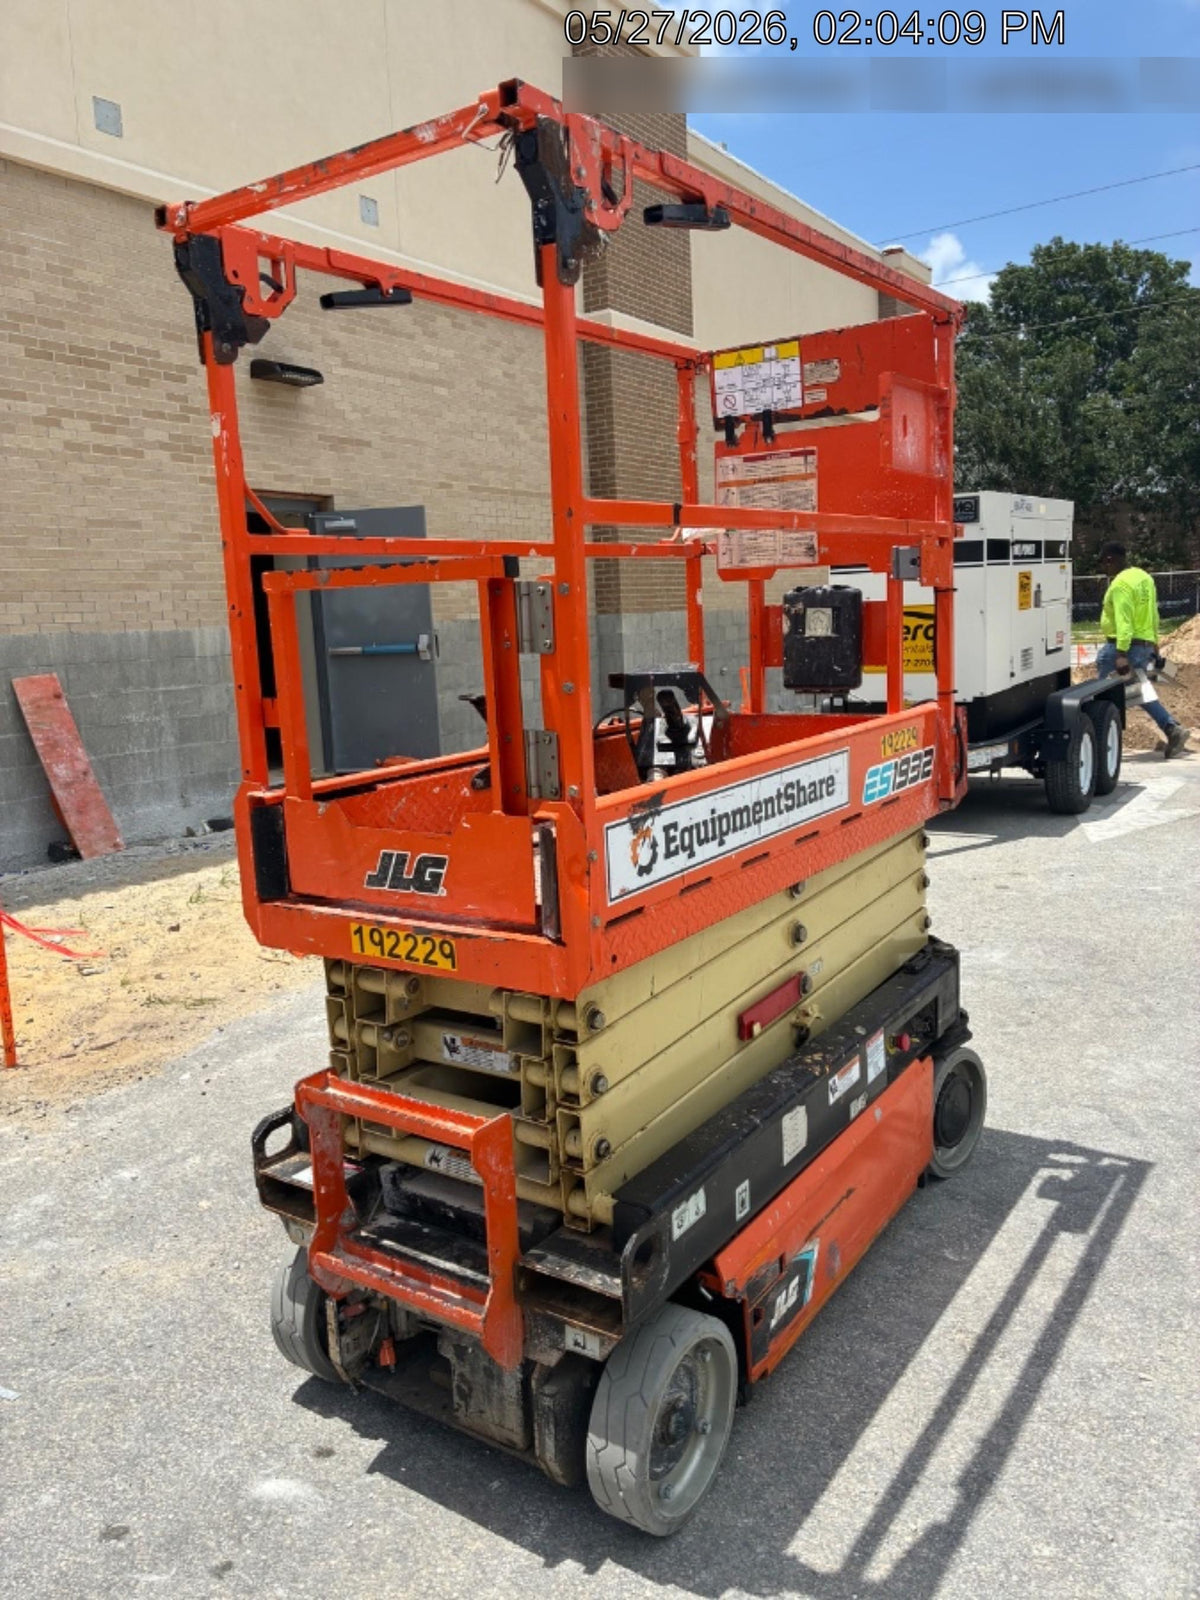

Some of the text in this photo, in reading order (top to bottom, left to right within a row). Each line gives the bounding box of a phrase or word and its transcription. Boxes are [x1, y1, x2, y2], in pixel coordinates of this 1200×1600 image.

[881, 726, 918, 757] 192229
[863, 746, 934, 805] ES1932
[662, 774, 835, 860] EquipmentShare
[364, 849, 449, 896] JLG
[353, 925, 456, 970] 192229
[769, 1274, 799, 1331] JLG
